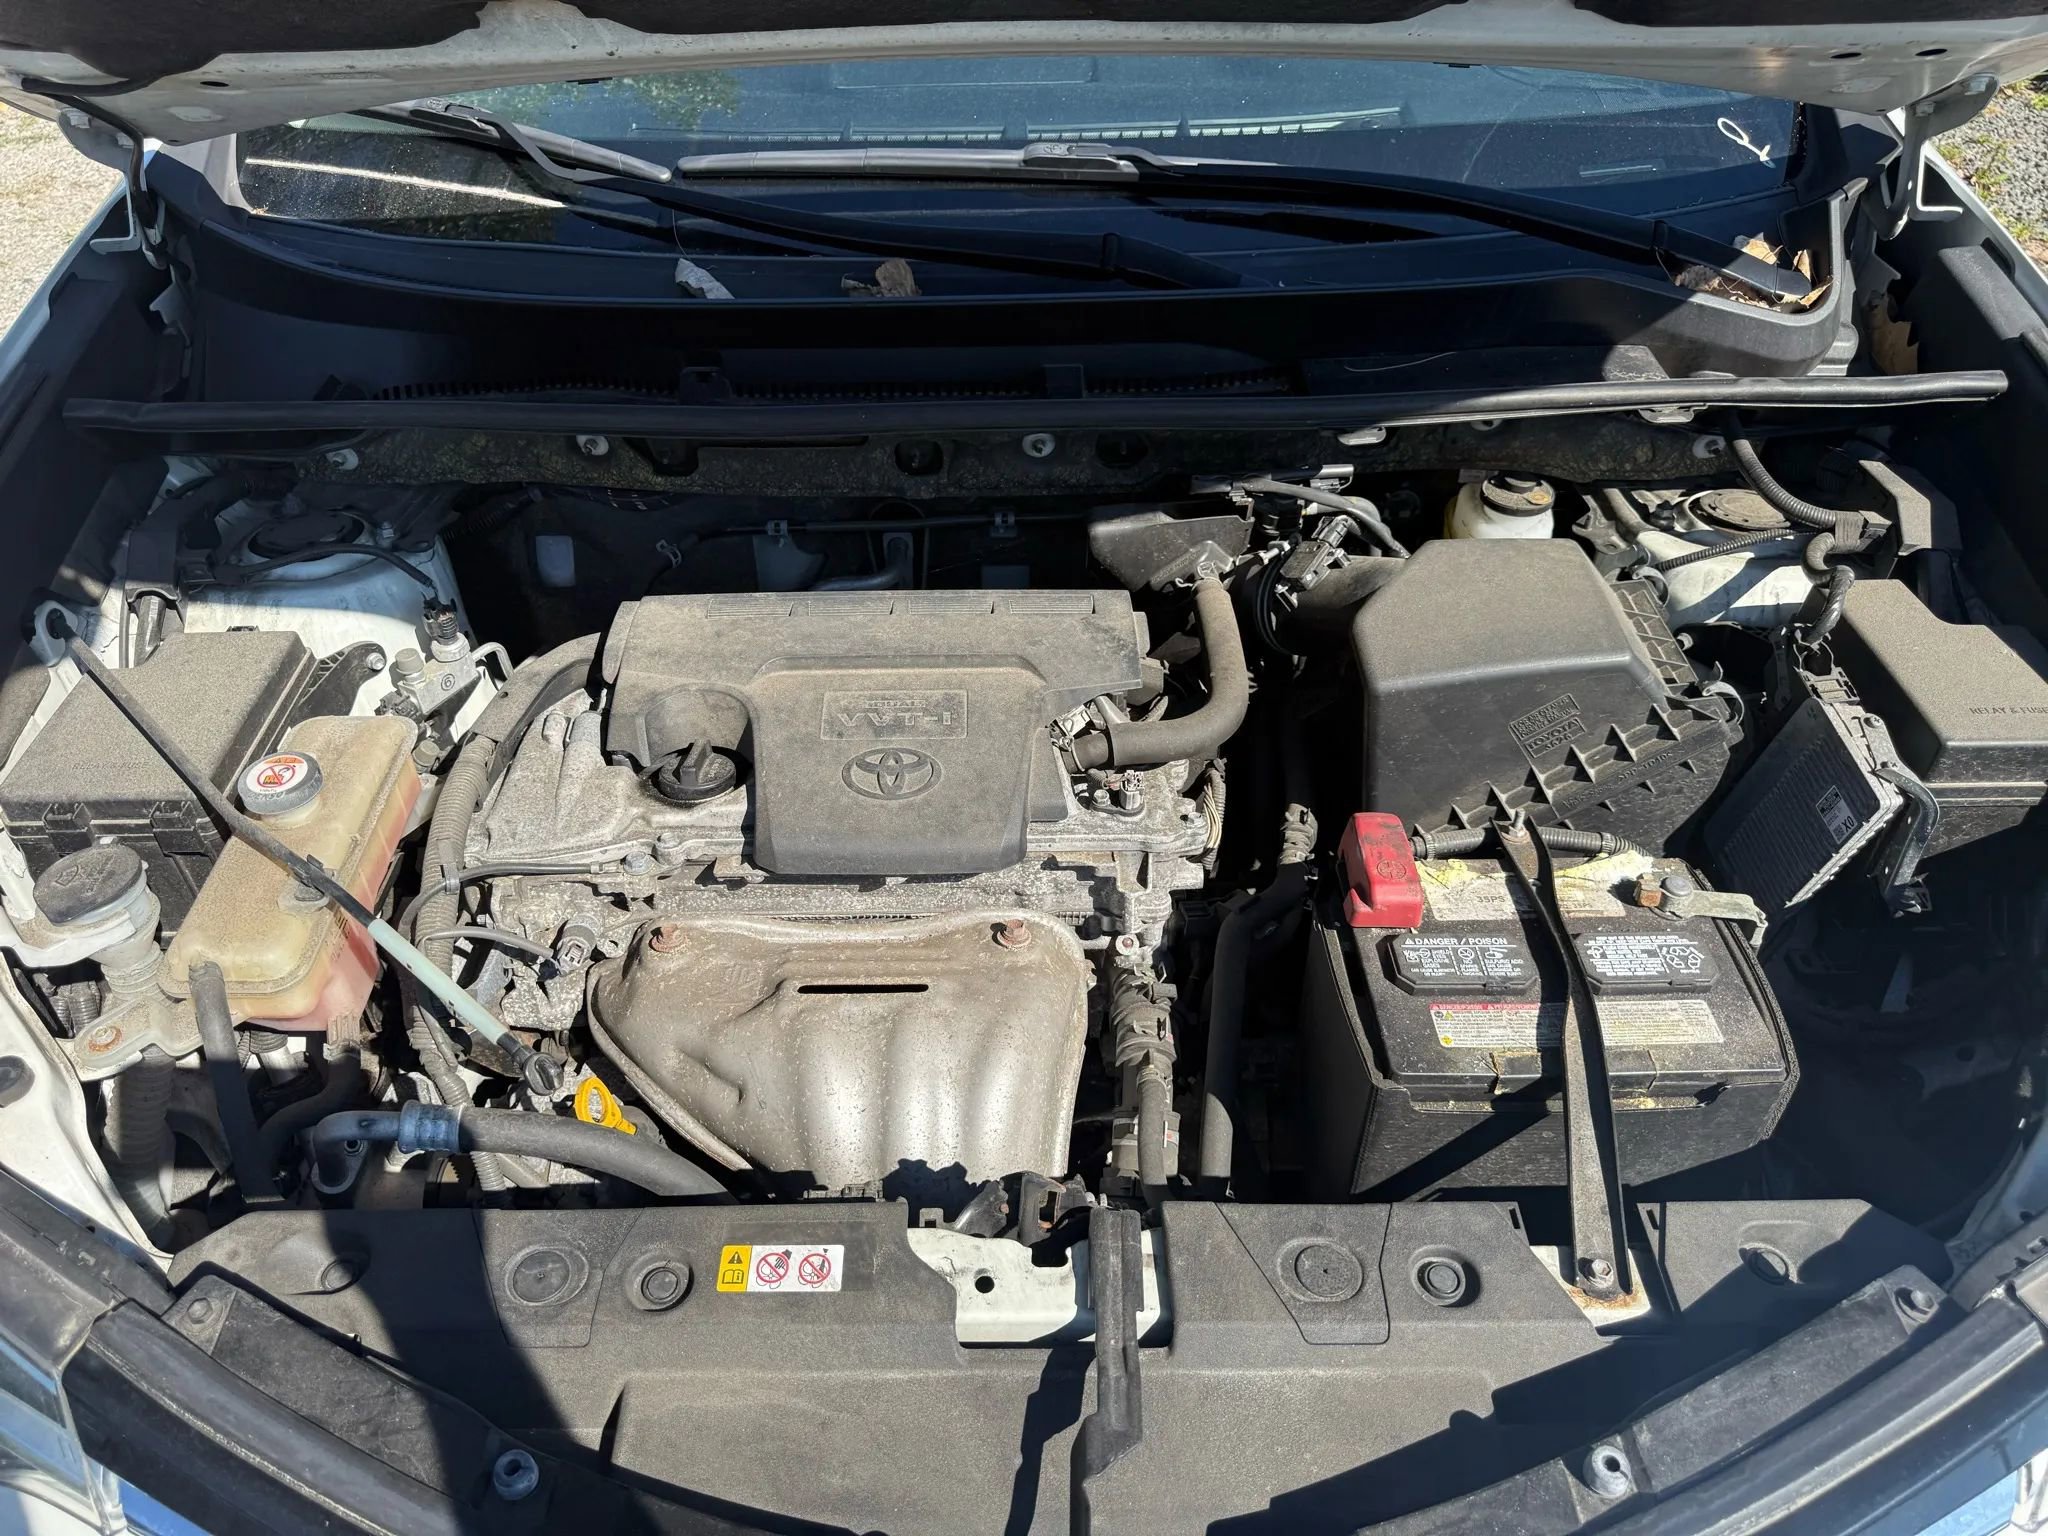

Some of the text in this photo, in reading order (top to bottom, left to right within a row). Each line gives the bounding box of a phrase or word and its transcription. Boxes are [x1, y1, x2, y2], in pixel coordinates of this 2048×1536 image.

[1969, 706, 2006, 714] RELAY
[1526, 718, 1580, 750] TOYOTA
[1414, 937, 1458, 946] DANGER
[1469, 937, 1508, 945] POISON
